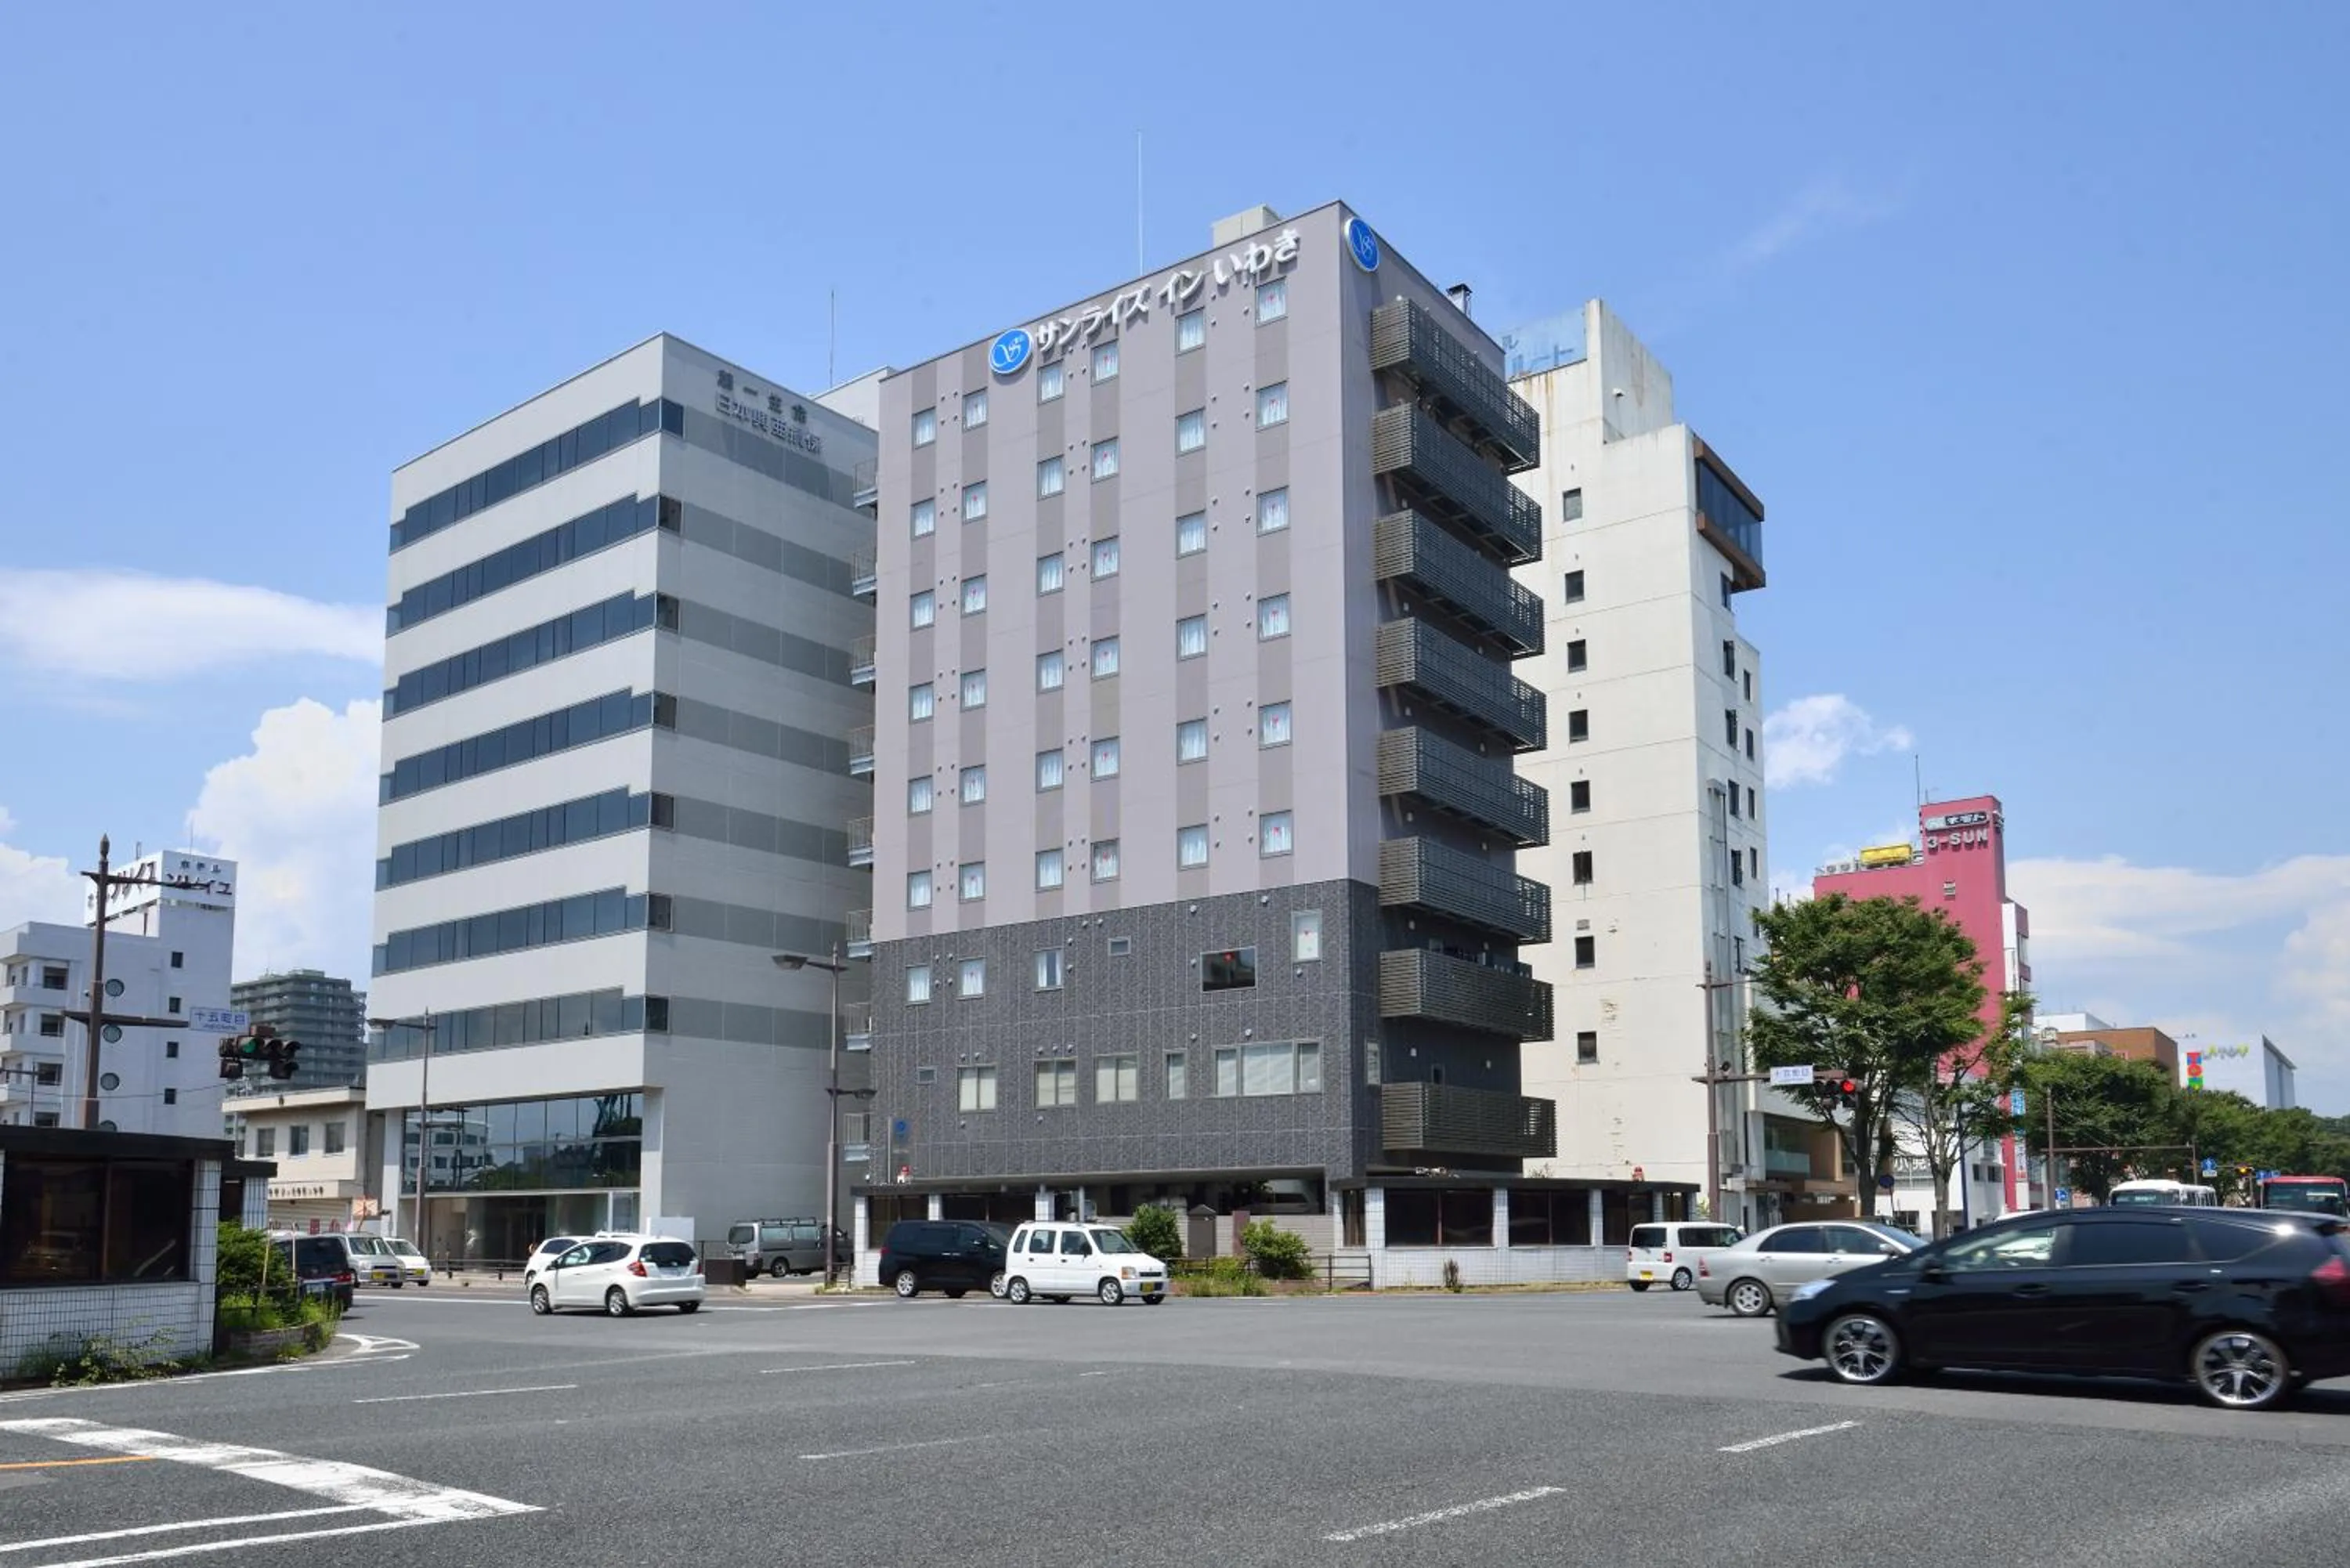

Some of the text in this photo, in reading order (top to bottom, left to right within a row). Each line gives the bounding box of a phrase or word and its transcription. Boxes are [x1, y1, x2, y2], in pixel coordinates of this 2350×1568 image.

[1036, 227, 1302, 352] サンライズ イン いわき
